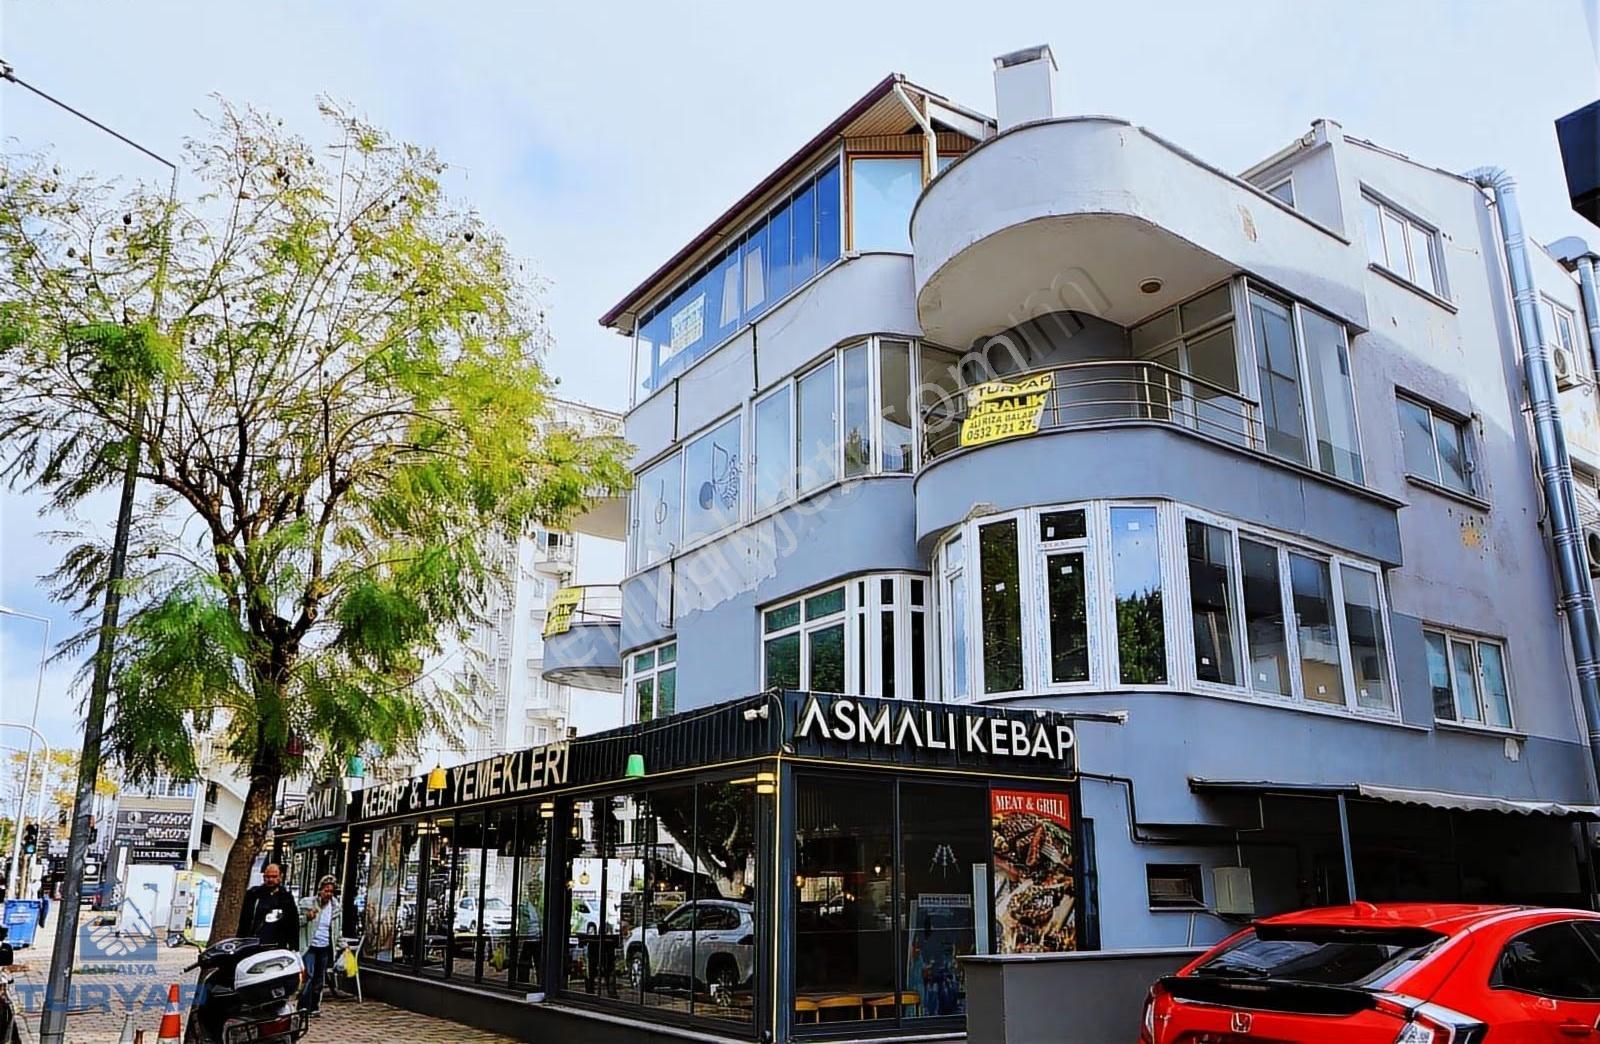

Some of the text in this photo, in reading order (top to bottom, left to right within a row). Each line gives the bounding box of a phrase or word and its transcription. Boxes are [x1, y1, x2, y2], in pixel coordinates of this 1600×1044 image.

[978, 374, 1051, 397] TURYAP
[966, 427, 992, 441] 0532
[995, 423, 1014, 435] 721
[800, 697, 1076, 760] ASMALI KEBAP
[362, 780, 409, 819] KEBAP
[409, 776, 421, 809] &
[995, 795, 1067, 820] MEAT & GRILL
